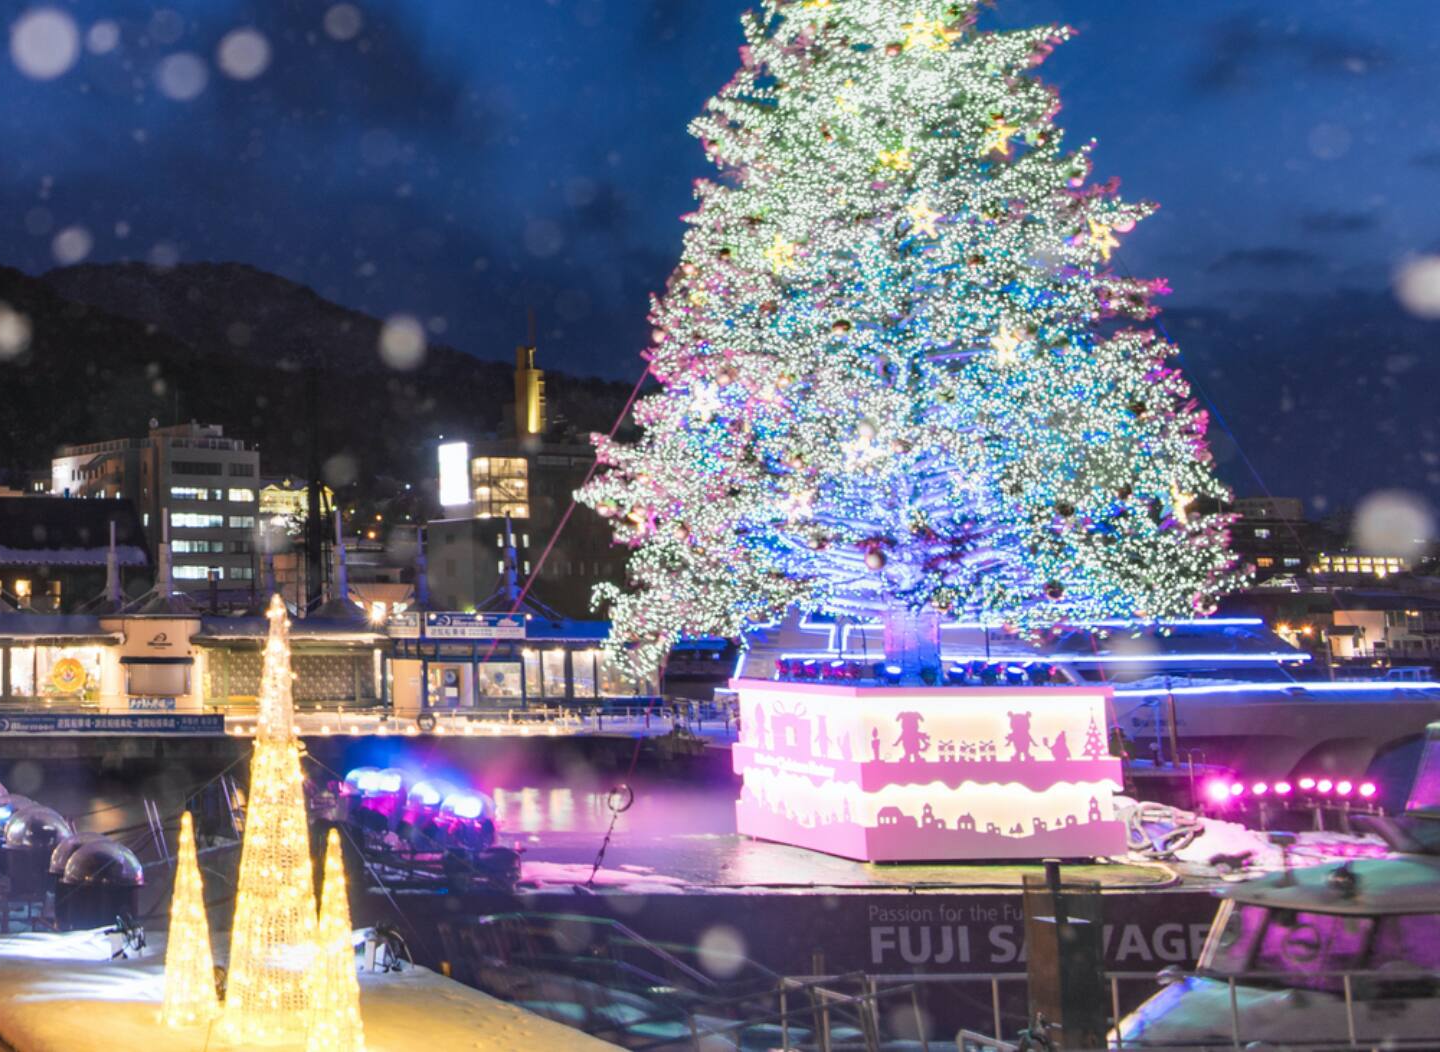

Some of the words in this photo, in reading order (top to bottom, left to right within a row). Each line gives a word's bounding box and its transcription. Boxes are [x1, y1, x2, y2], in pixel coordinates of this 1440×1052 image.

[869, 905, 932, 921] Passion
[940, 904, 963, 921] for
[970, 905, 998, 921] the
[1004, 904, 1024, 921] Fu
[870, 926, 970, 963] FUJI
